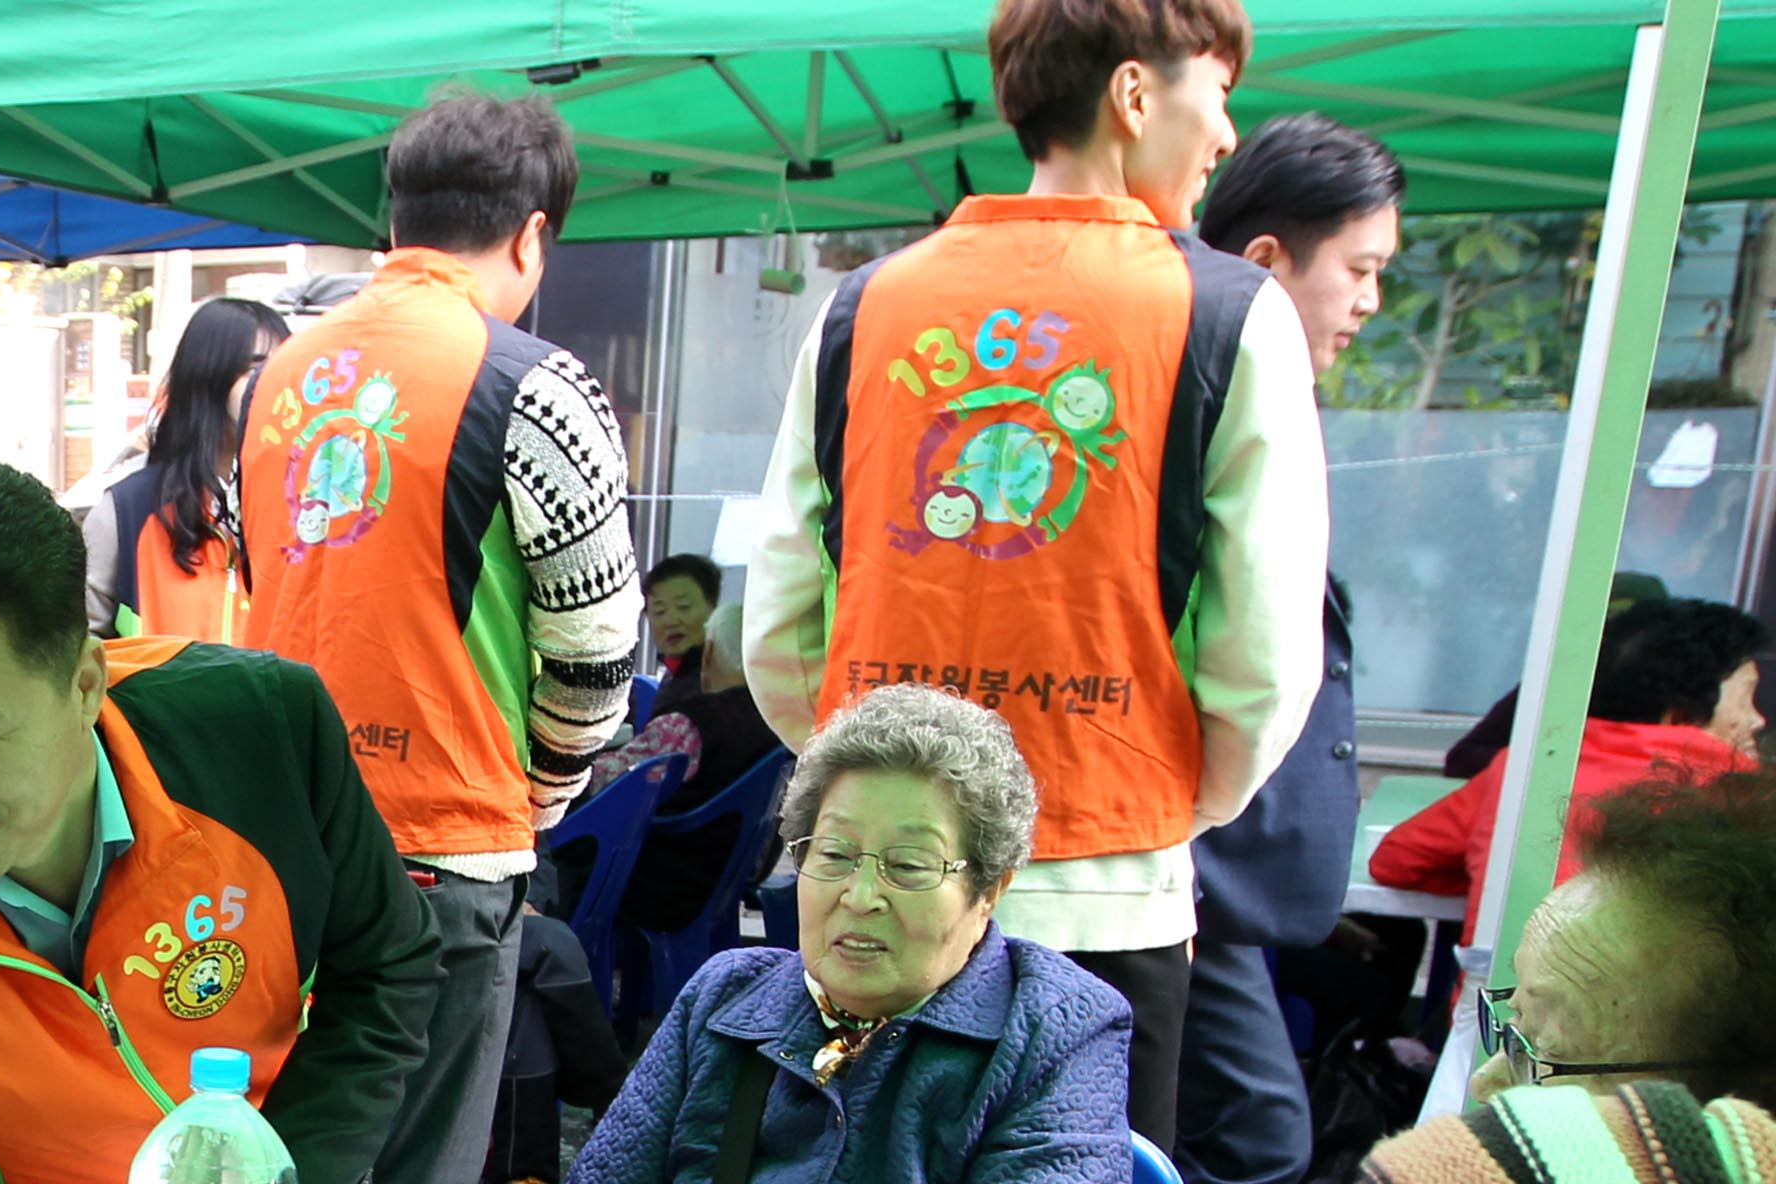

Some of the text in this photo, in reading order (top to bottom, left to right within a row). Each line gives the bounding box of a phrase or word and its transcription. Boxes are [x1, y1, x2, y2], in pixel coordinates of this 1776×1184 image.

[260, 349, 362, 445] 1365
[888, 308, 1071, 397] 1365
[349, 722, 411, 762] 센터
[124, 885, 247, 979] 1365
